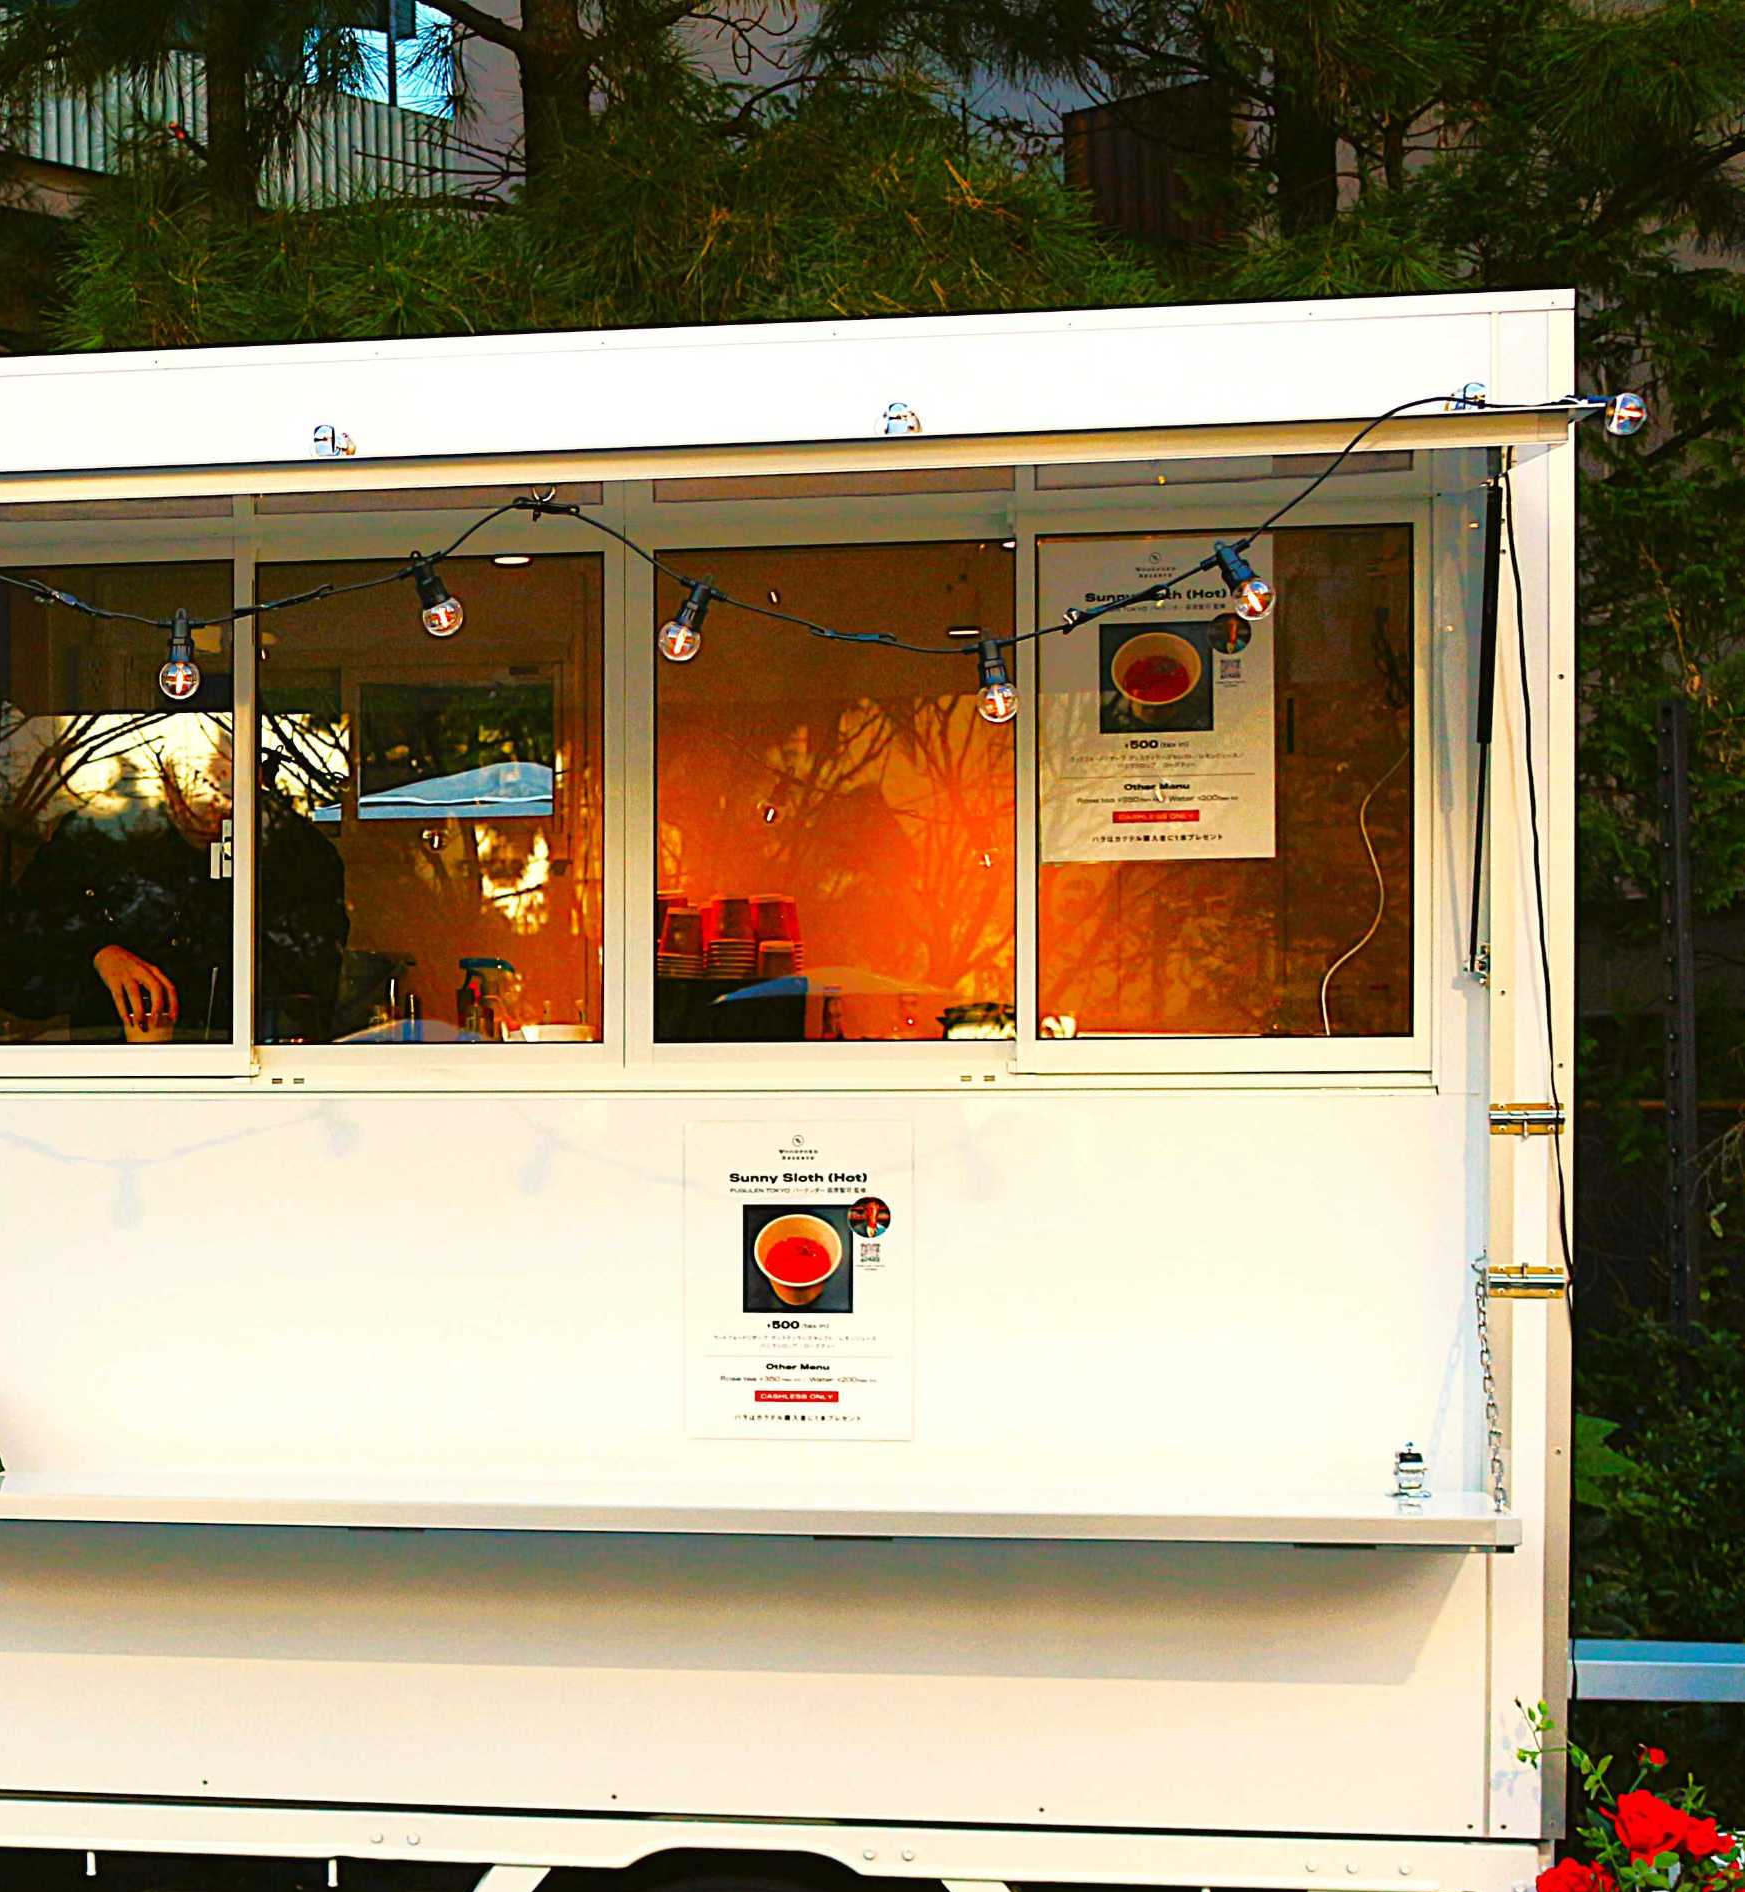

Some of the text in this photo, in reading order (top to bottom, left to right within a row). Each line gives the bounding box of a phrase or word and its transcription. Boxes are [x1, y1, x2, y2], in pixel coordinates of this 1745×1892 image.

[1186, 588, 1227, 600] (Hot)
[1124, 783, 1157, 791] Other
[729, 1172, 868, 1185] Sunny Sloth (Hot)
[766, 1363, 831, 1371] Other Menu
